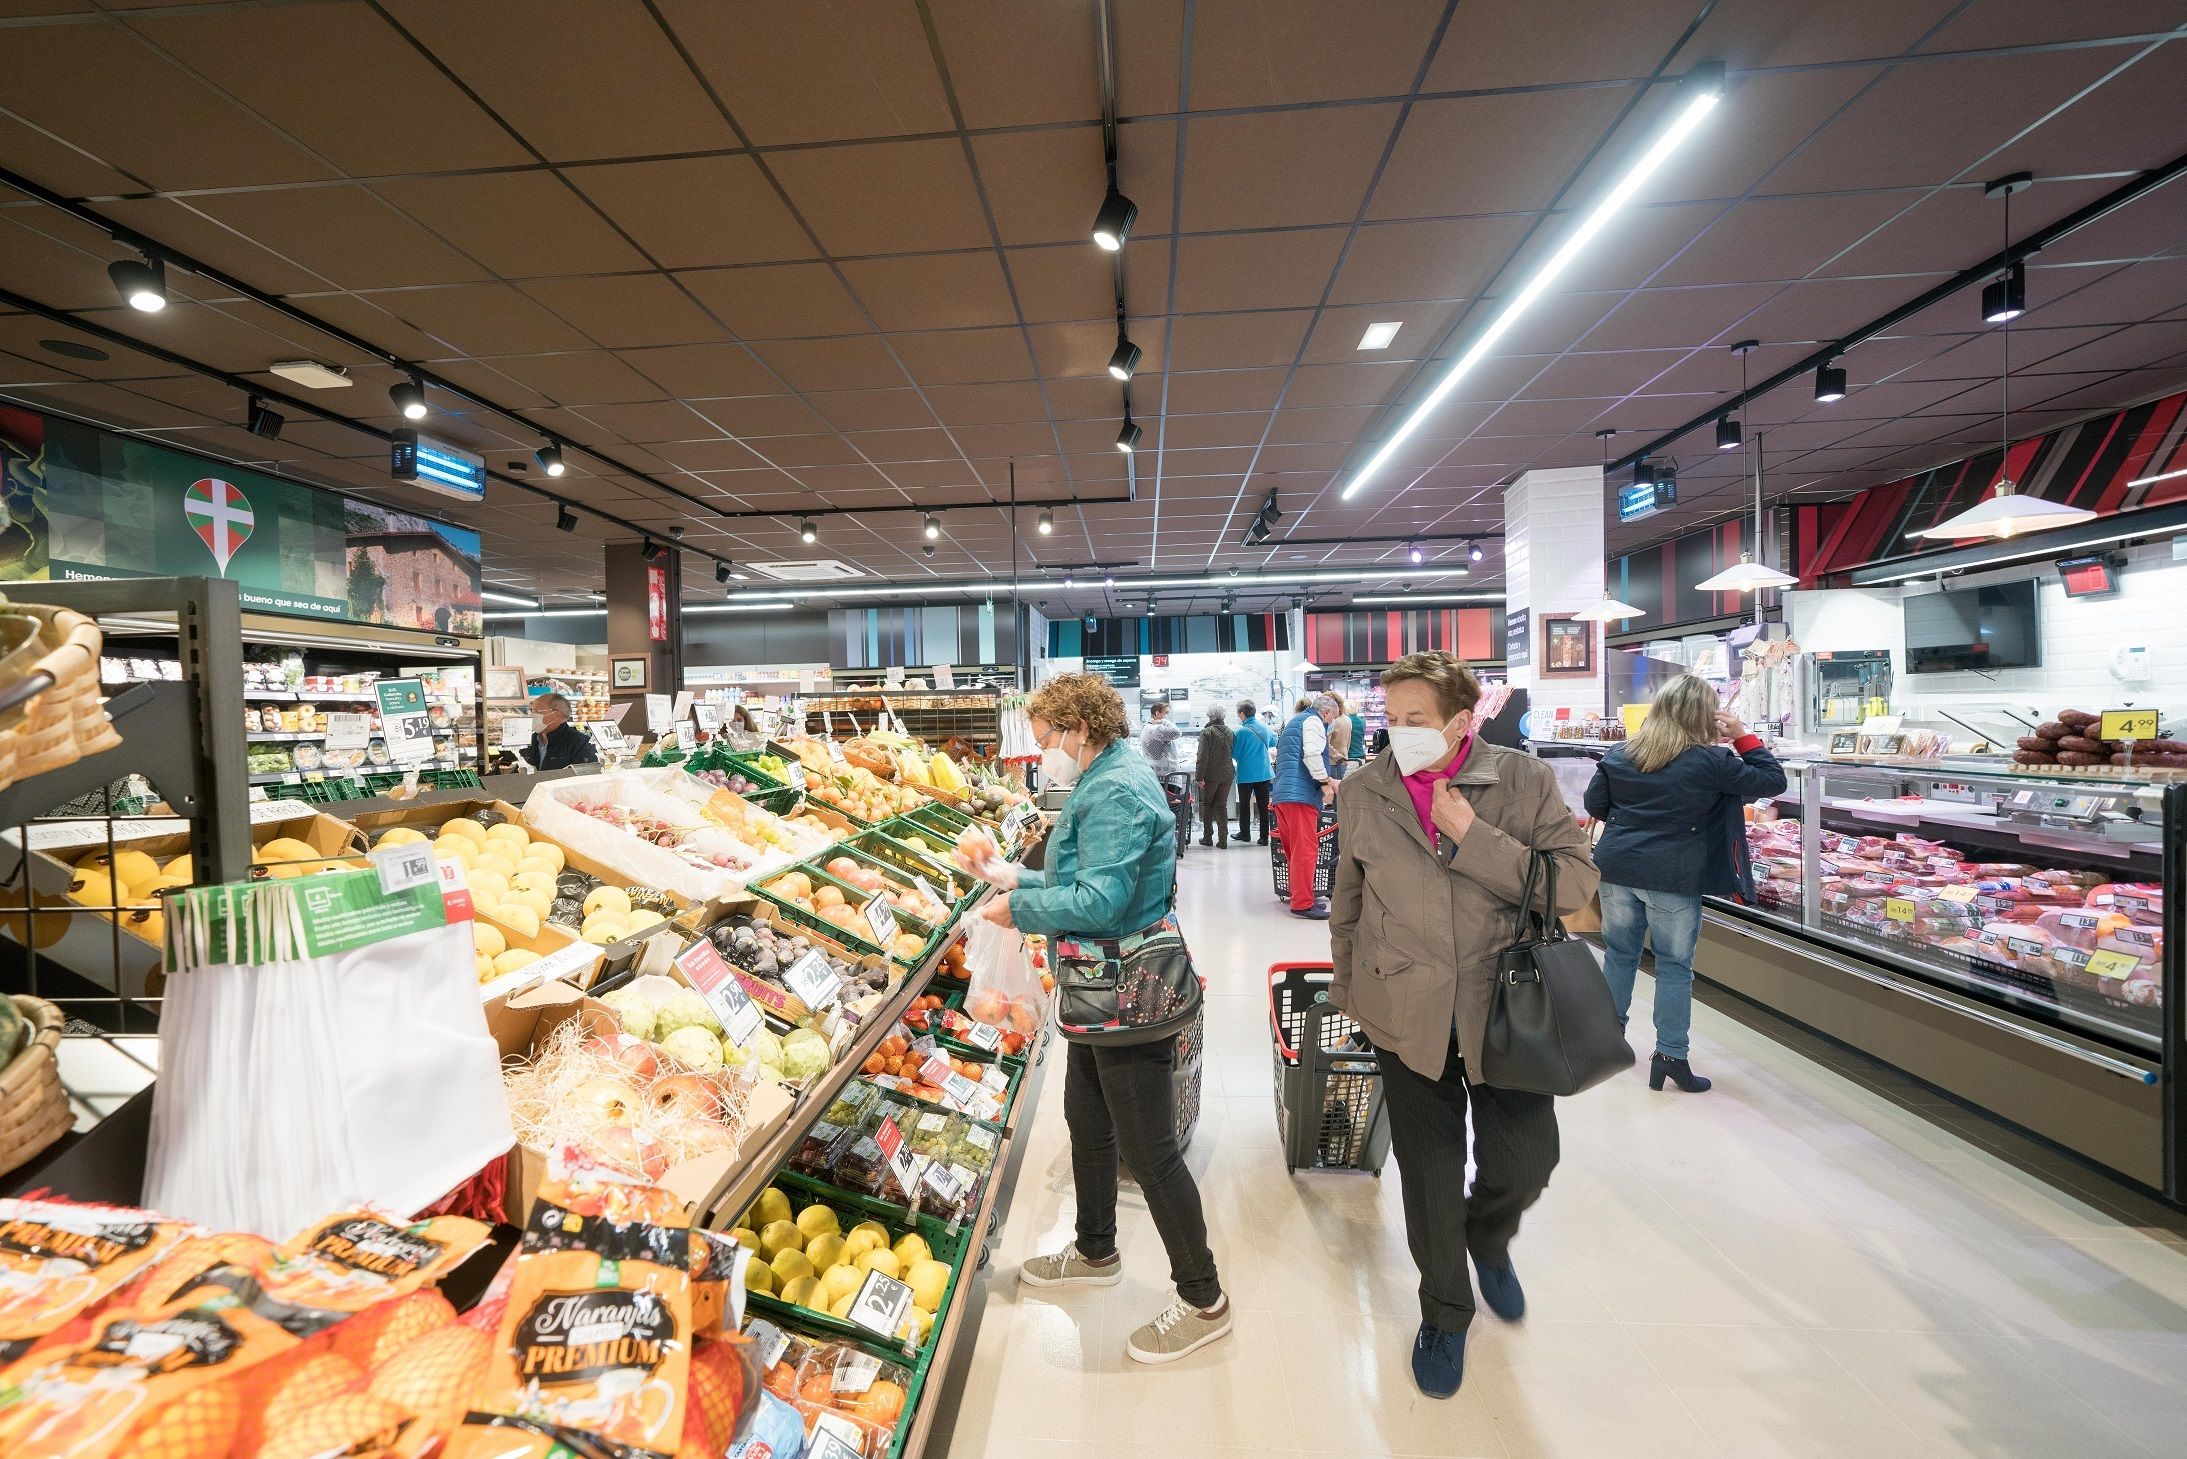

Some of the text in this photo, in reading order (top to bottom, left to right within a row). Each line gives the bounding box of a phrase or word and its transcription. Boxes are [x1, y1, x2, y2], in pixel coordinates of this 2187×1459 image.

[243, 593, 273, 605] bueno
[275, 598, 292, 608] que
[293, 601, 309, 609] sea
[310, 602, 321, 610] de
[322, 605, 340, 613] aquí
[534, 1294, 662, 1336] Naranjas
[867, 1274, 894, 1318] 2,25
[523, 1336, 659, 1375] PREMIUM
